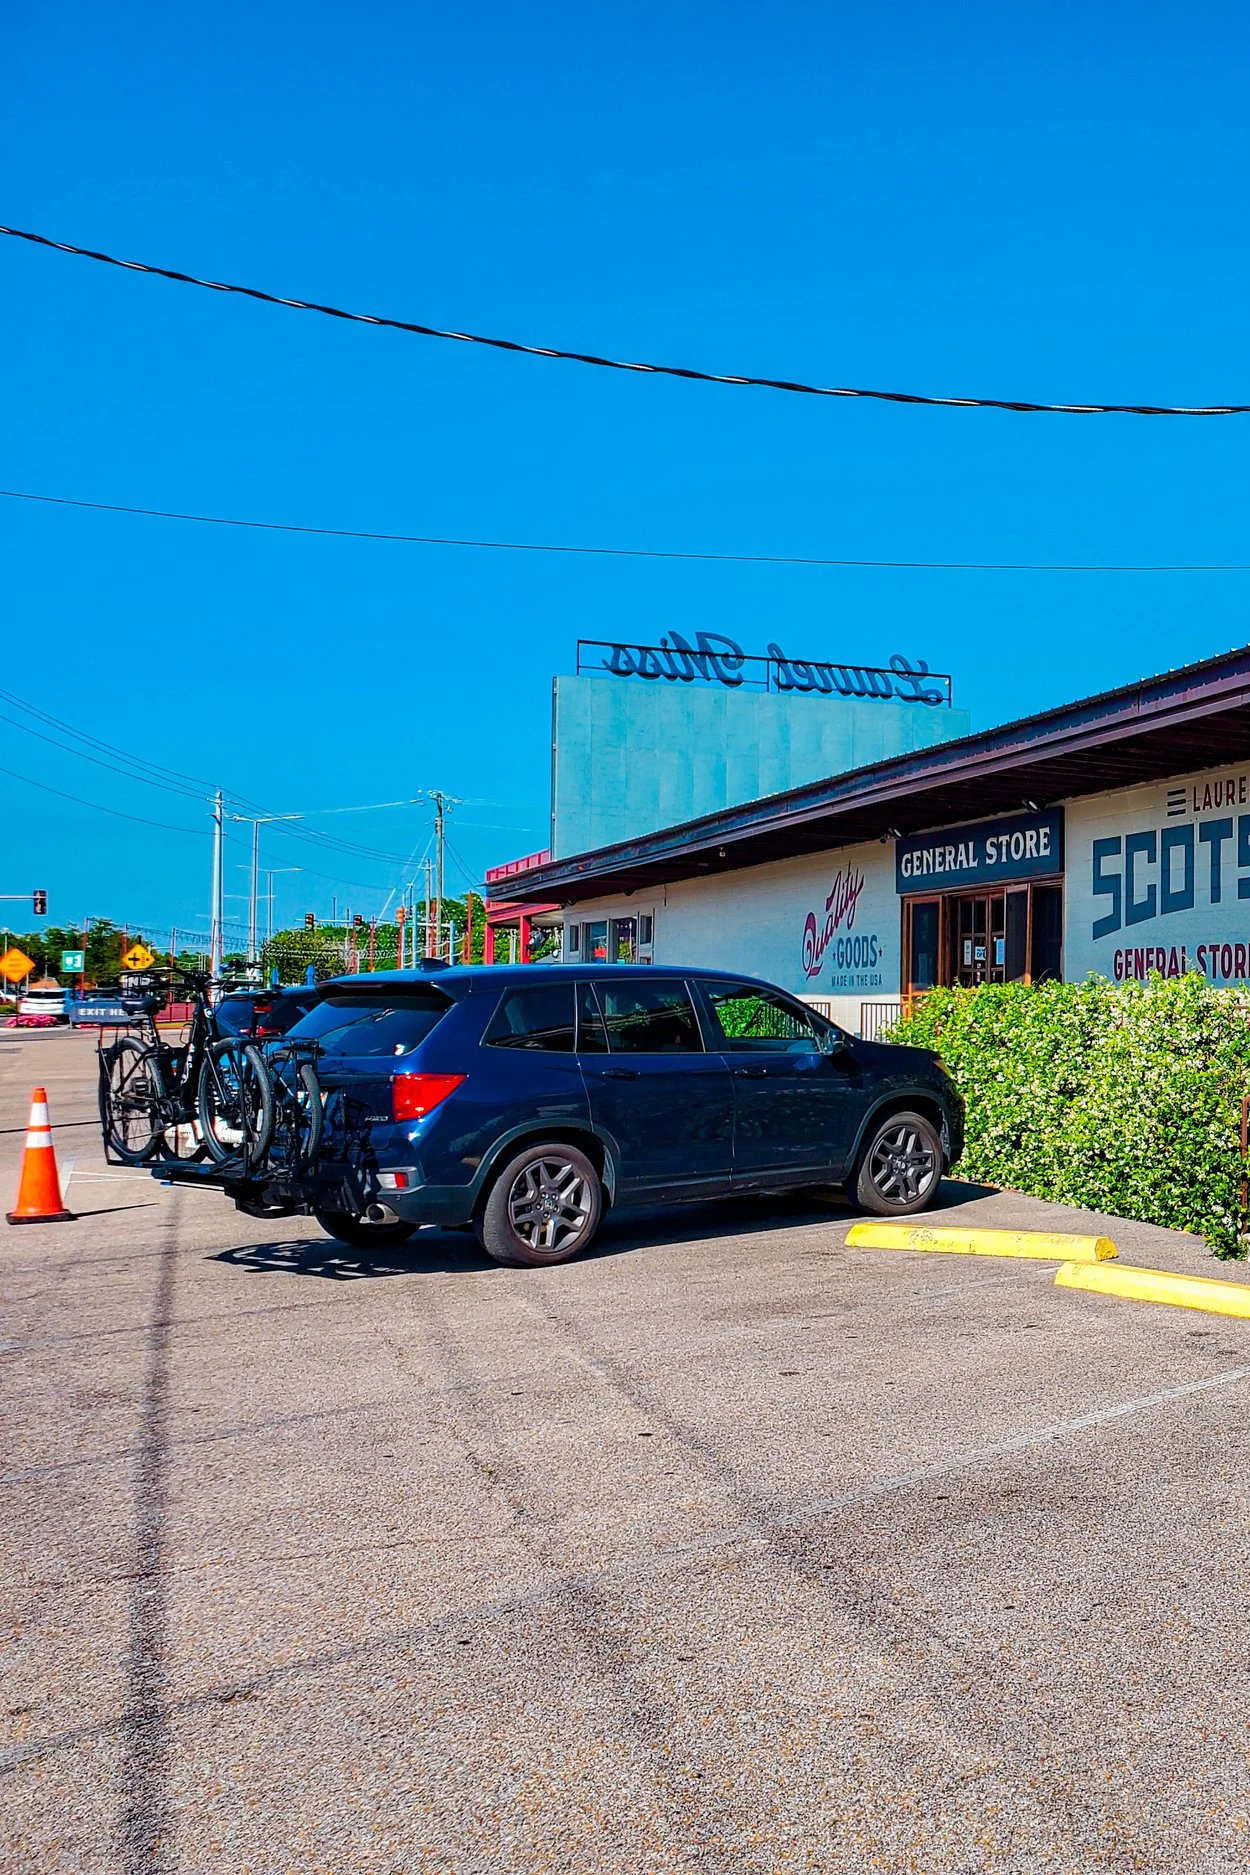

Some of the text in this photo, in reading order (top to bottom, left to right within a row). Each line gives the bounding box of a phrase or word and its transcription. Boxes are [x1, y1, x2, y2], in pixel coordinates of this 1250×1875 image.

[901, 826, 1051, 878] GENERAL STORE
[802, 860, 865, 981] Quality
[837, 935, 878, 969] GOODS
[832, 974, 883, 987] MADE IN THE USA
[79, 1008, 106, 1016] EXIT
